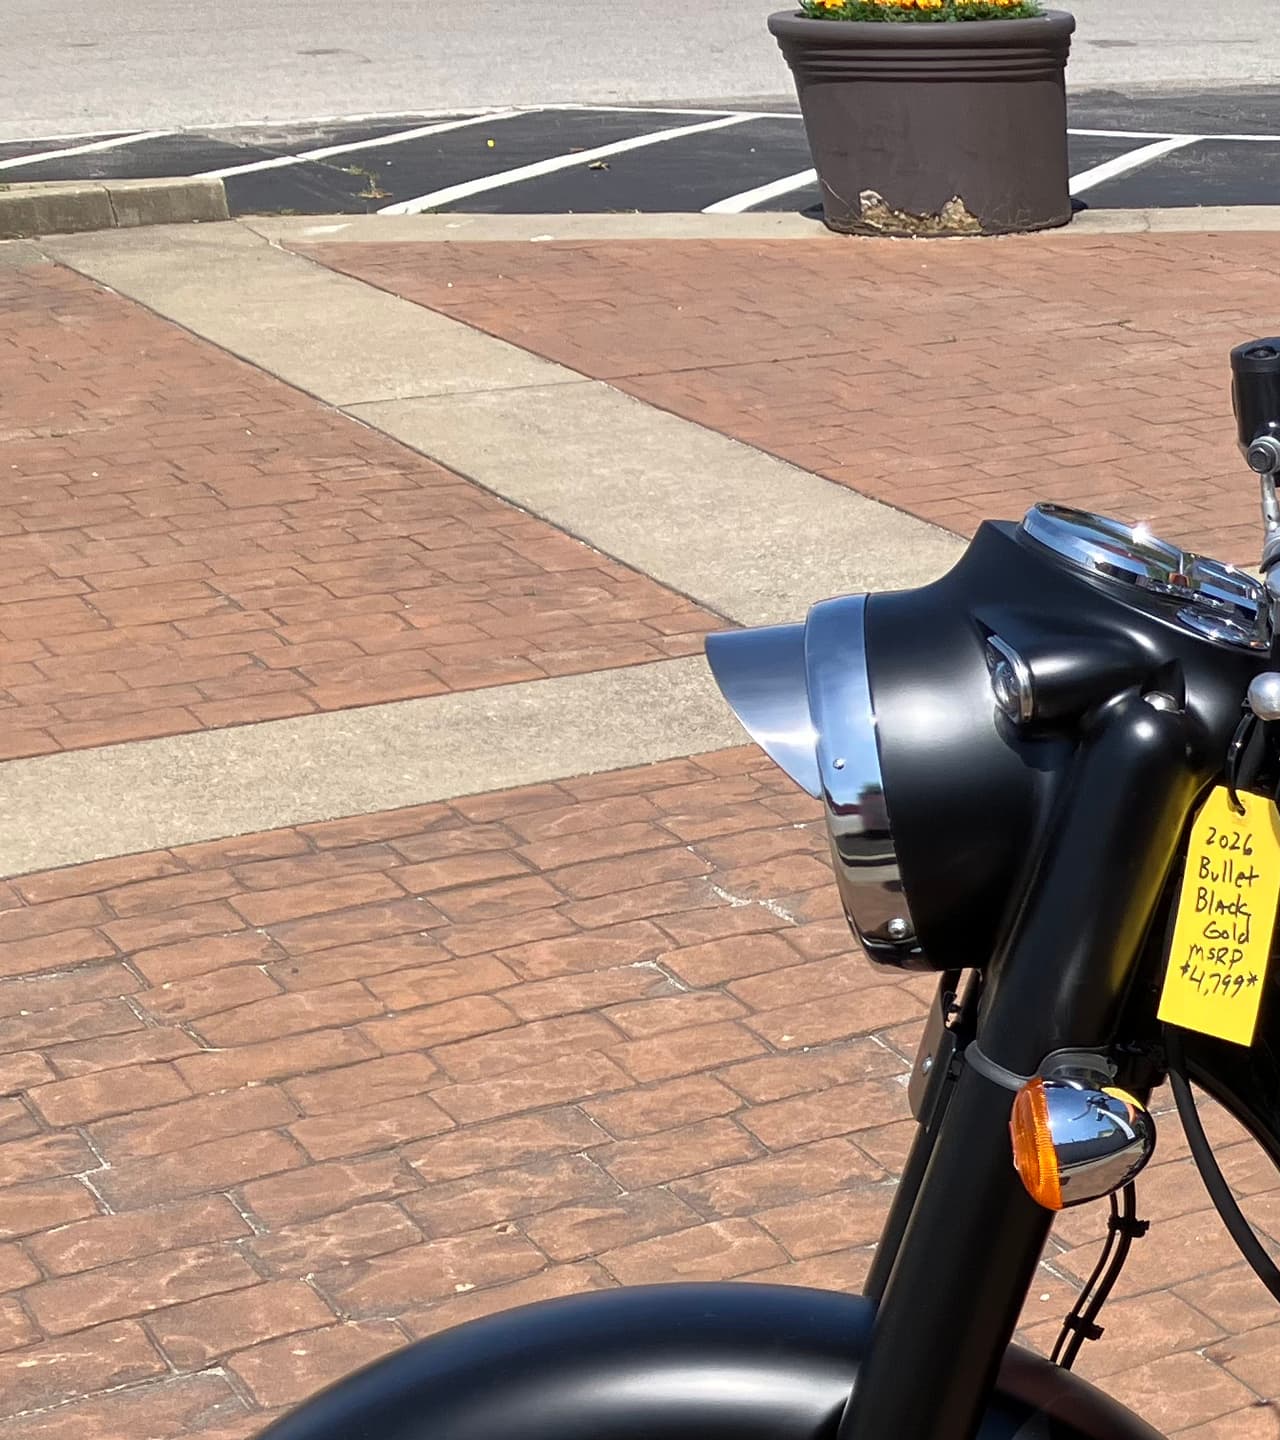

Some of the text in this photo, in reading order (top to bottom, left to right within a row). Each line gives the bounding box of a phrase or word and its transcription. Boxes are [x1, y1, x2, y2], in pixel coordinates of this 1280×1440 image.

[1206, 827, 1253, 856] 2026
[1199, 855, 1260, 888] Bullet
[1203, 915, 1250, 944] Gold
